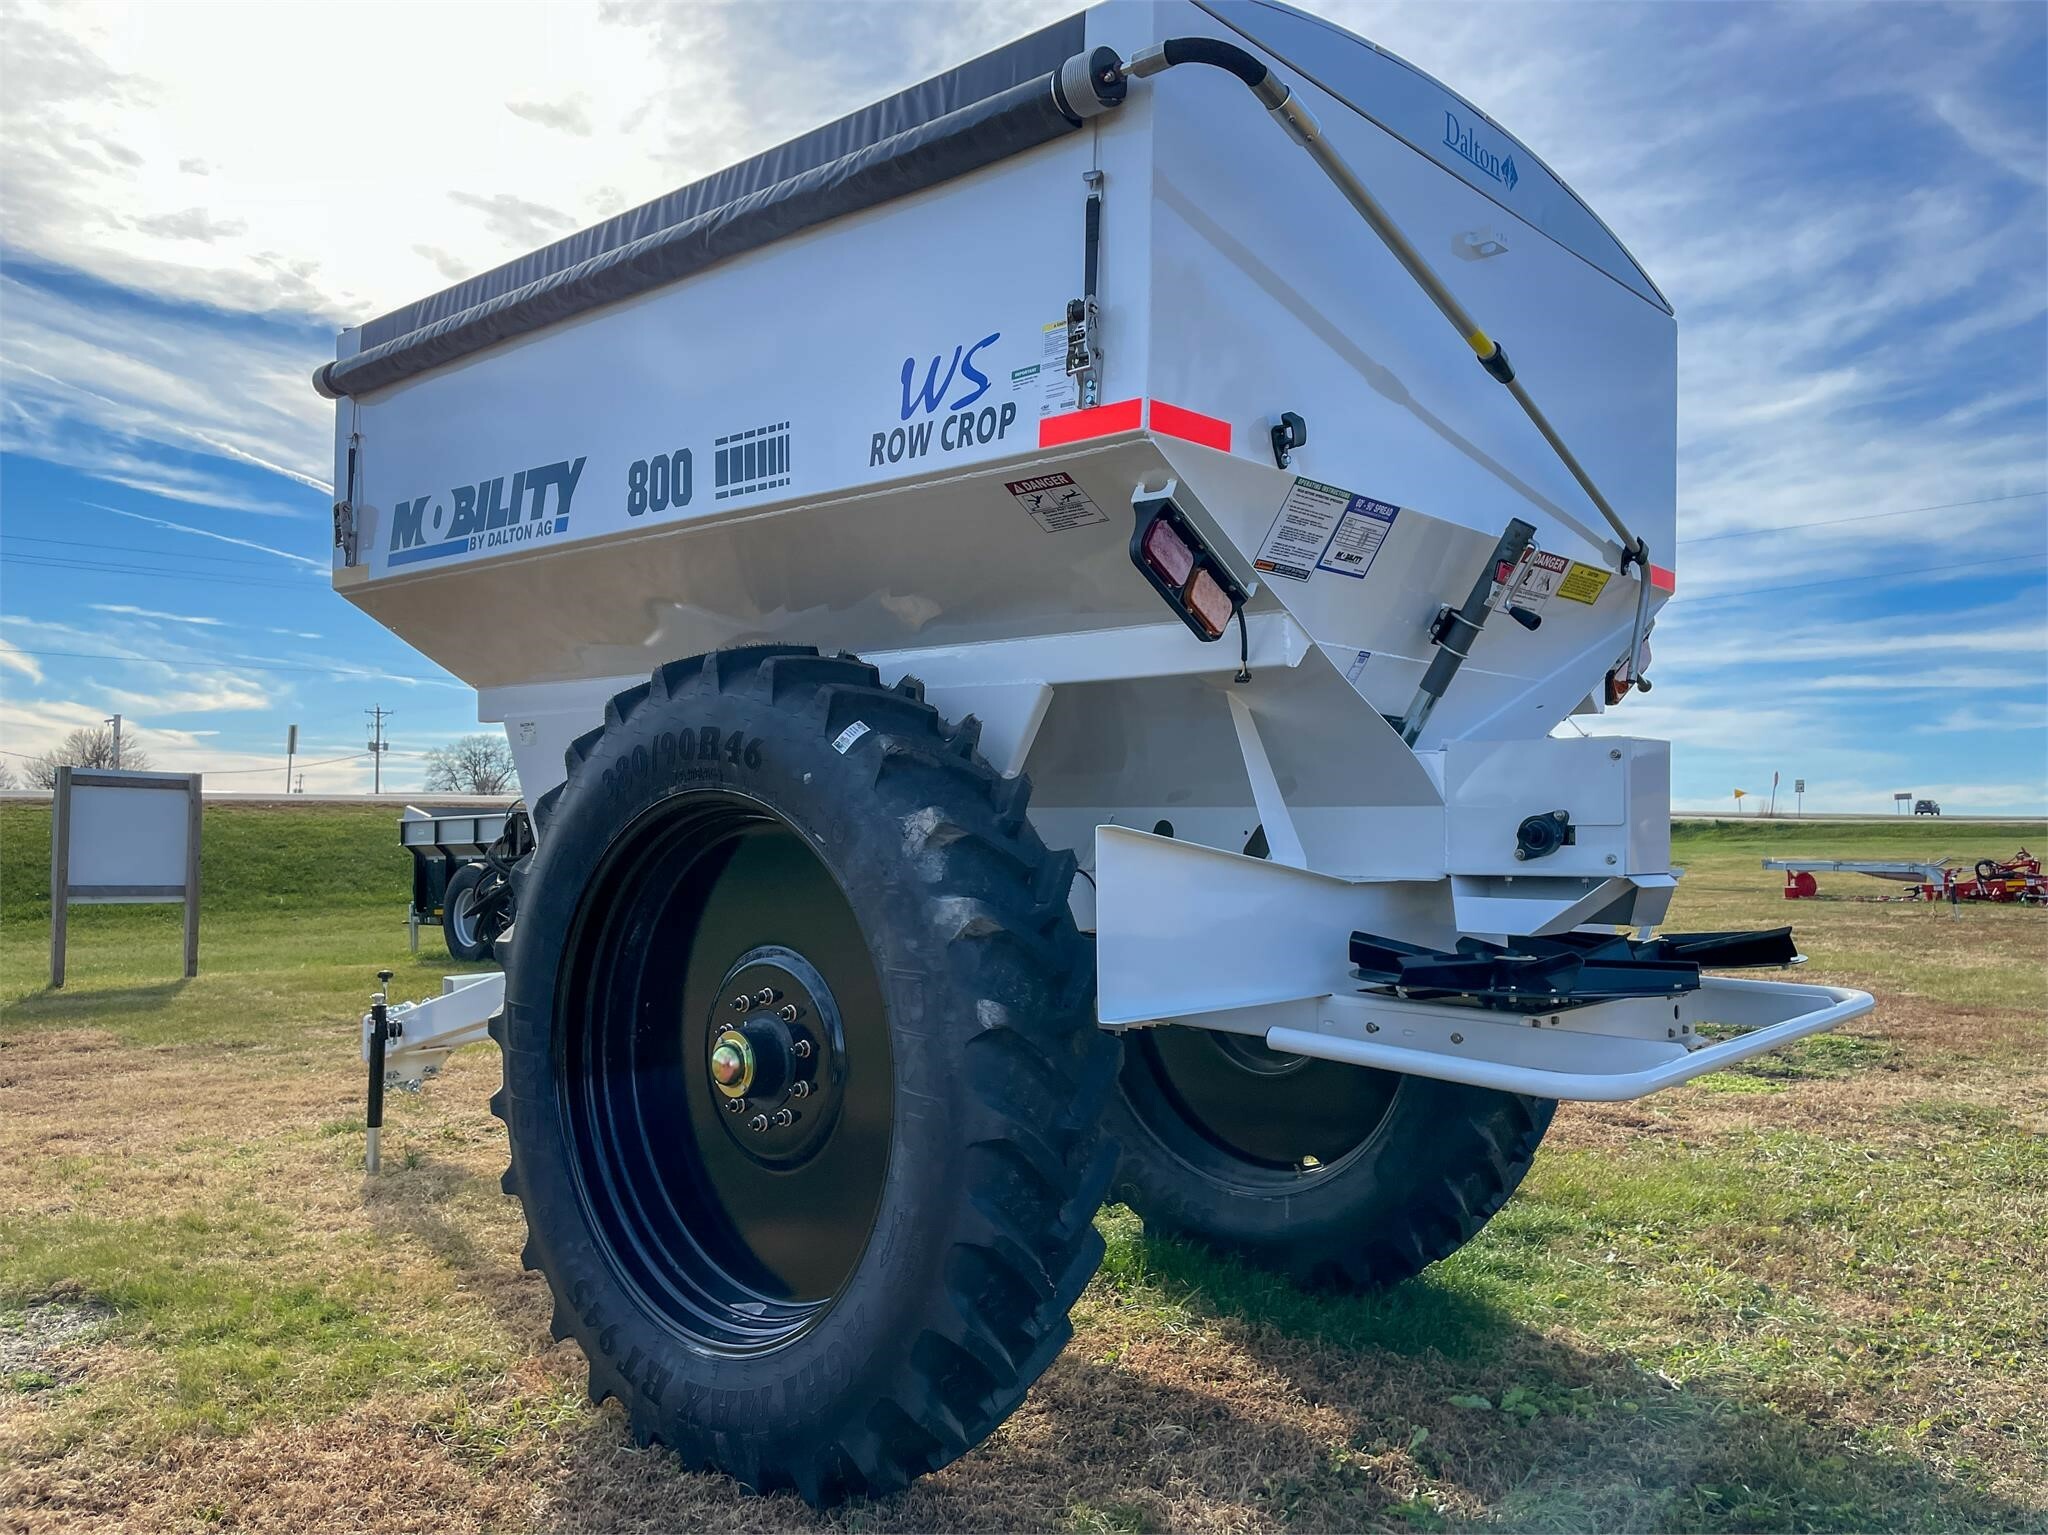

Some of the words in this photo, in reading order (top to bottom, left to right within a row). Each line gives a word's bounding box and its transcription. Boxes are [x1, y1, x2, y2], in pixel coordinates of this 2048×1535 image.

[1444, 110, 1501, 177] Dalton
[901, 332, 1000, 421] WS
[869, 420, 934, 467] ROW
[940, 401, 1017, 452] CROP
[389, 456, 588, 551] MOBILITY
[627, 447, 692, 517] 800
[1021, 474, 1069, 491] DANGER
[1297, 478, 1323, 493] OPERATING
[1321, 483, 1352, 500] INSTRUCTIONS
[1373, 502, 1394, 517] SPREAD
[469, 534, 485, 551] BY
[487, 523, 532, 547] DALTON
[536, 519, 552, 536] AG
